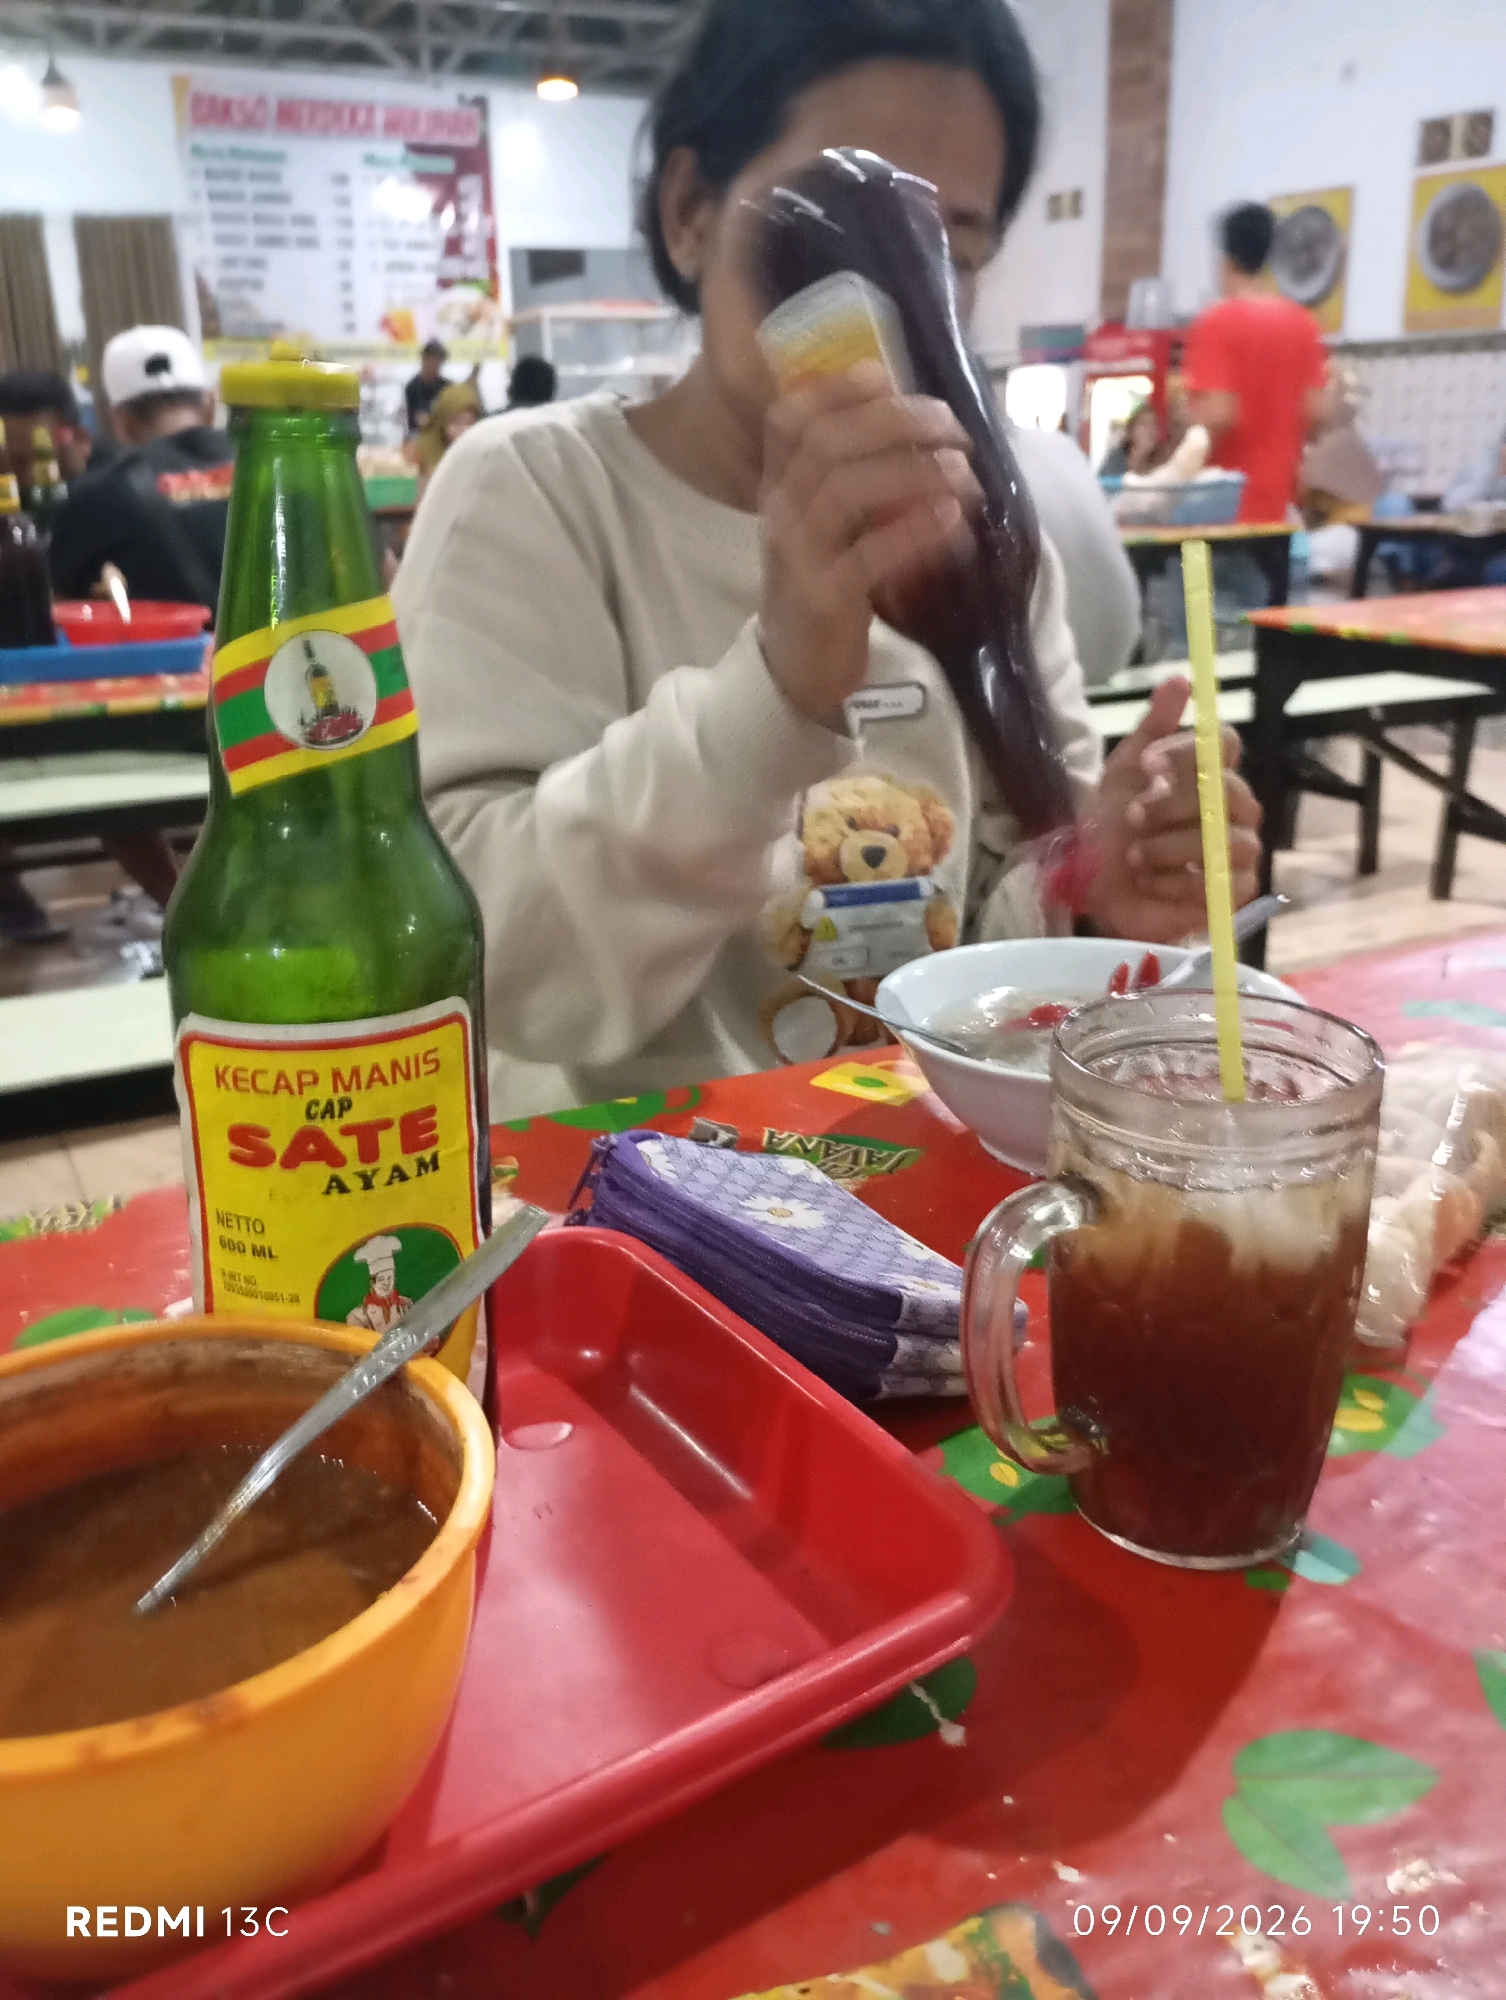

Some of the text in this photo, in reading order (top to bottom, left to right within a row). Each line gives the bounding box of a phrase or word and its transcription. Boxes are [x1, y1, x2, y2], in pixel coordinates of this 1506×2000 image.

[215, 1048, 440, 1096] KECAP MANIS
[305, 1096, 353, 1121] CAP
[227, 1104, 440, 1169] SATE
[322, 1151, 441, 1195] AYAM
[216, 1208, 265, 1235] NETTO
[219, 1234, 246, 1254] 600
